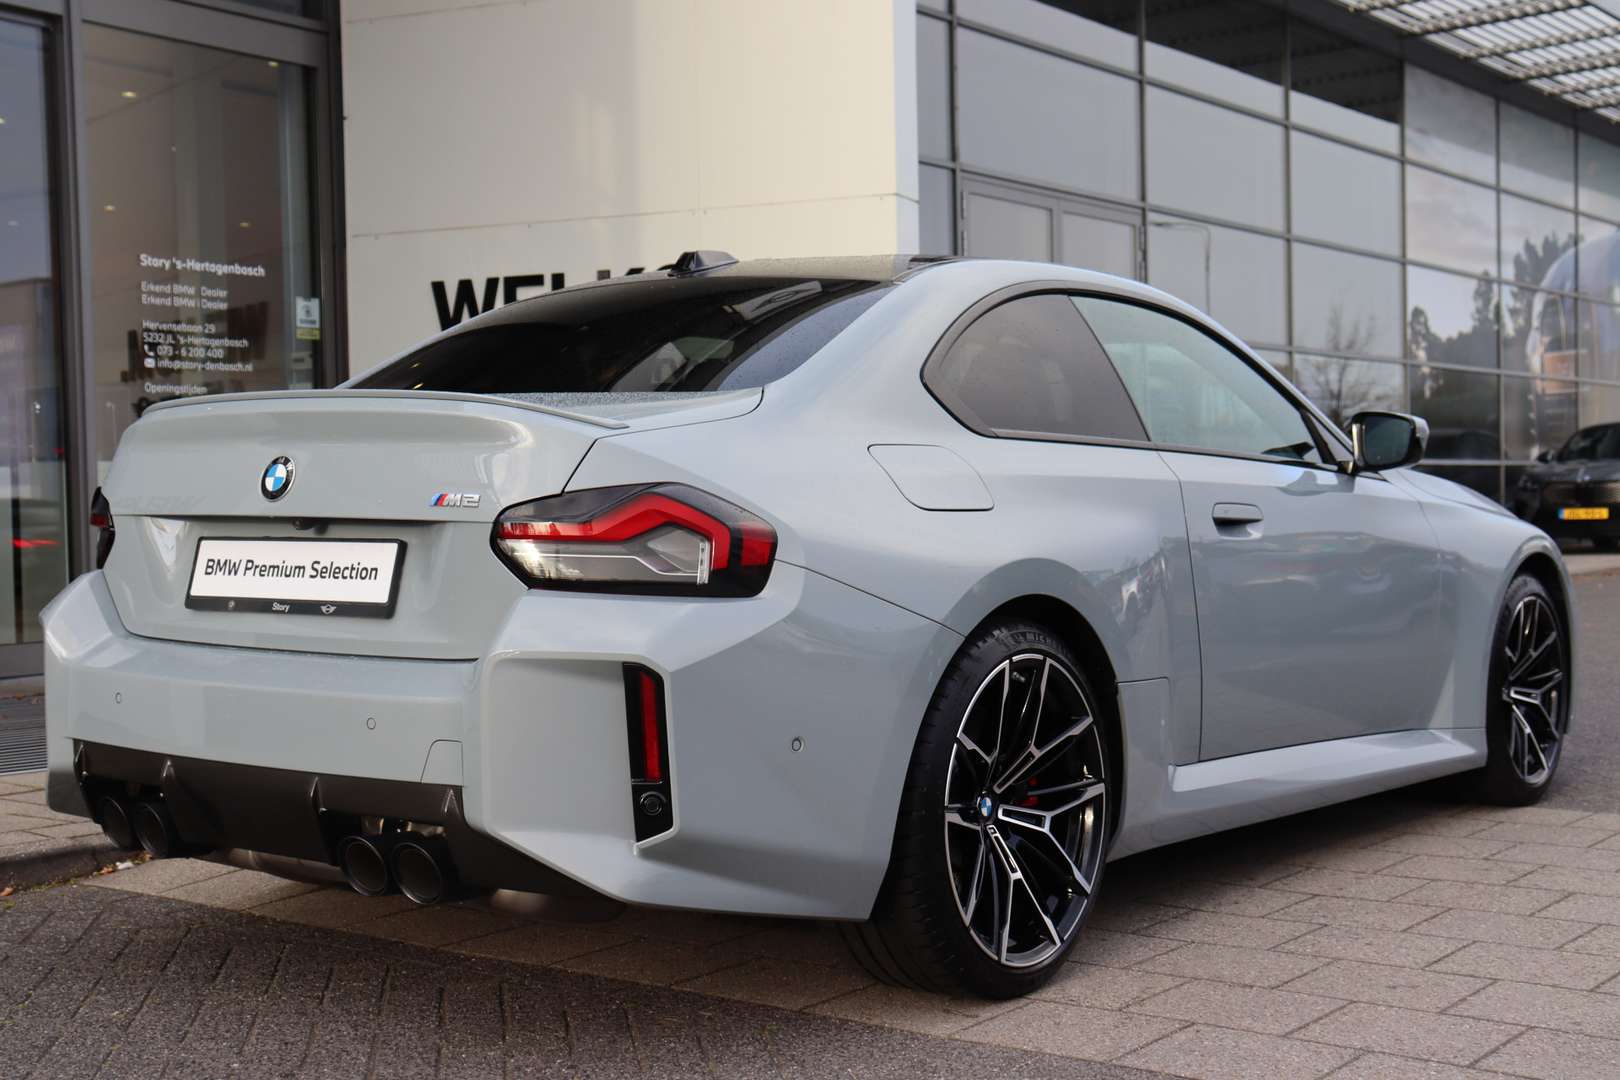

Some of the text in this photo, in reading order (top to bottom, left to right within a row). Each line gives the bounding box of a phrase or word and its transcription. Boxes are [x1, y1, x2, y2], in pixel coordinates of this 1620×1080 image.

[140, 254, 265, 277] Story 's-Hertogenbosch
[141, 281, 228, 298] Erkend BMW Dealer
[142, 294, 171, 306] Erkend
[173, 296, 196, 308] BMW
[201, 298, 229, 310] Dealer
[204, 323, 216, 334] 29
[143, 332, 165, 344] 5232
[165, 335, 175, 345] JL
[156, 346, 174, 357] 073
[180, 348, 187, 357] 6
[187, 347, 205, 358] 200
[206, 348, 225, 359] 400
[204, 558, 379, 582] BMW Premium Selection
[272, 602, 291, 613] Story
